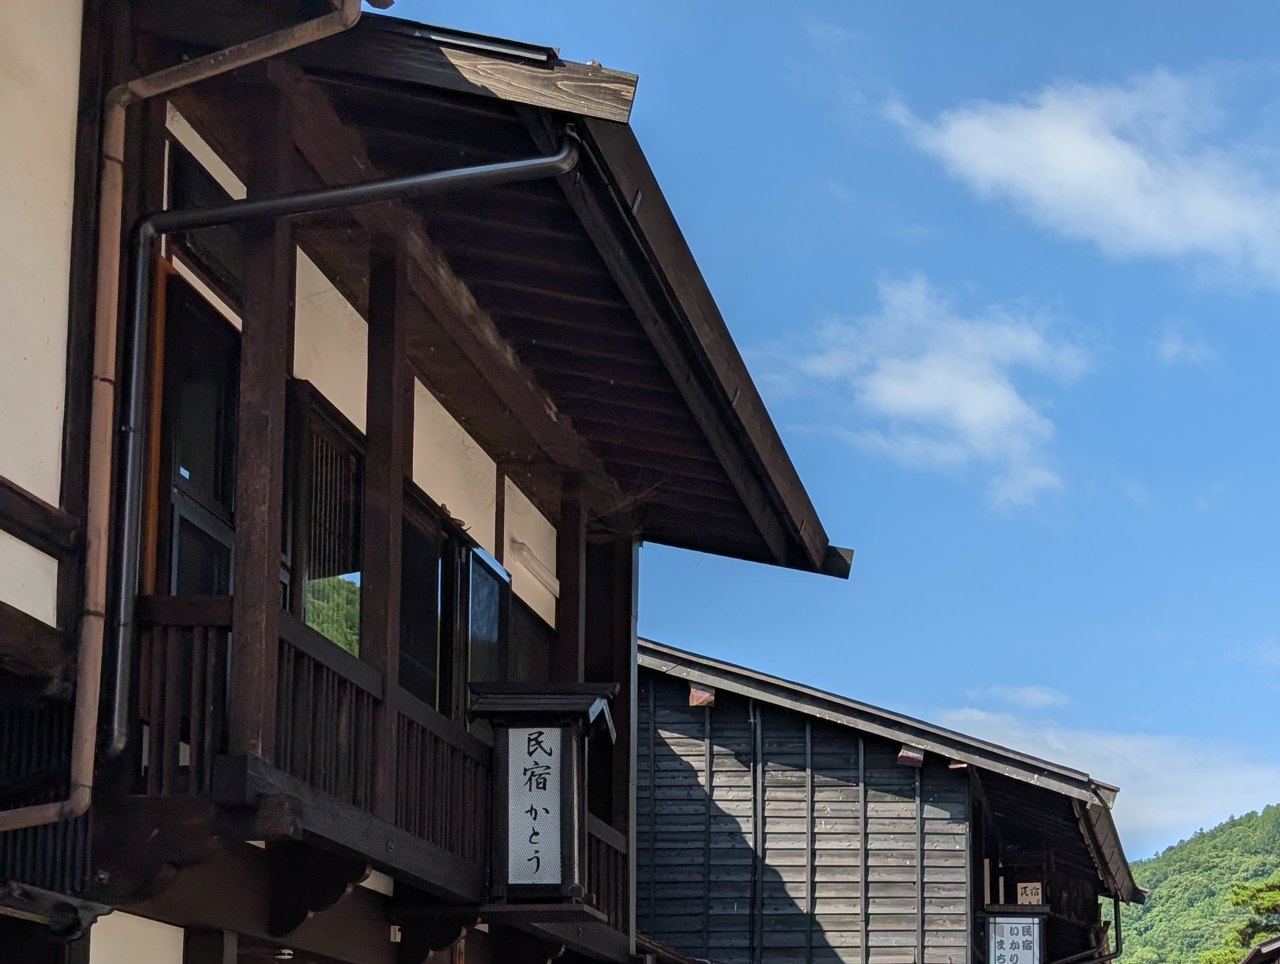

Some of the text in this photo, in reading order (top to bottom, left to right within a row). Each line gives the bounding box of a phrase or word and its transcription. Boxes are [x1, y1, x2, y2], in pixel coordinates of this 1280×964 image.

[523, 731, 552, 873] 民宿 かとう
[1020, 886, 1040, 897] 民宿
[1022, 925, 1033, 951] 民宿
